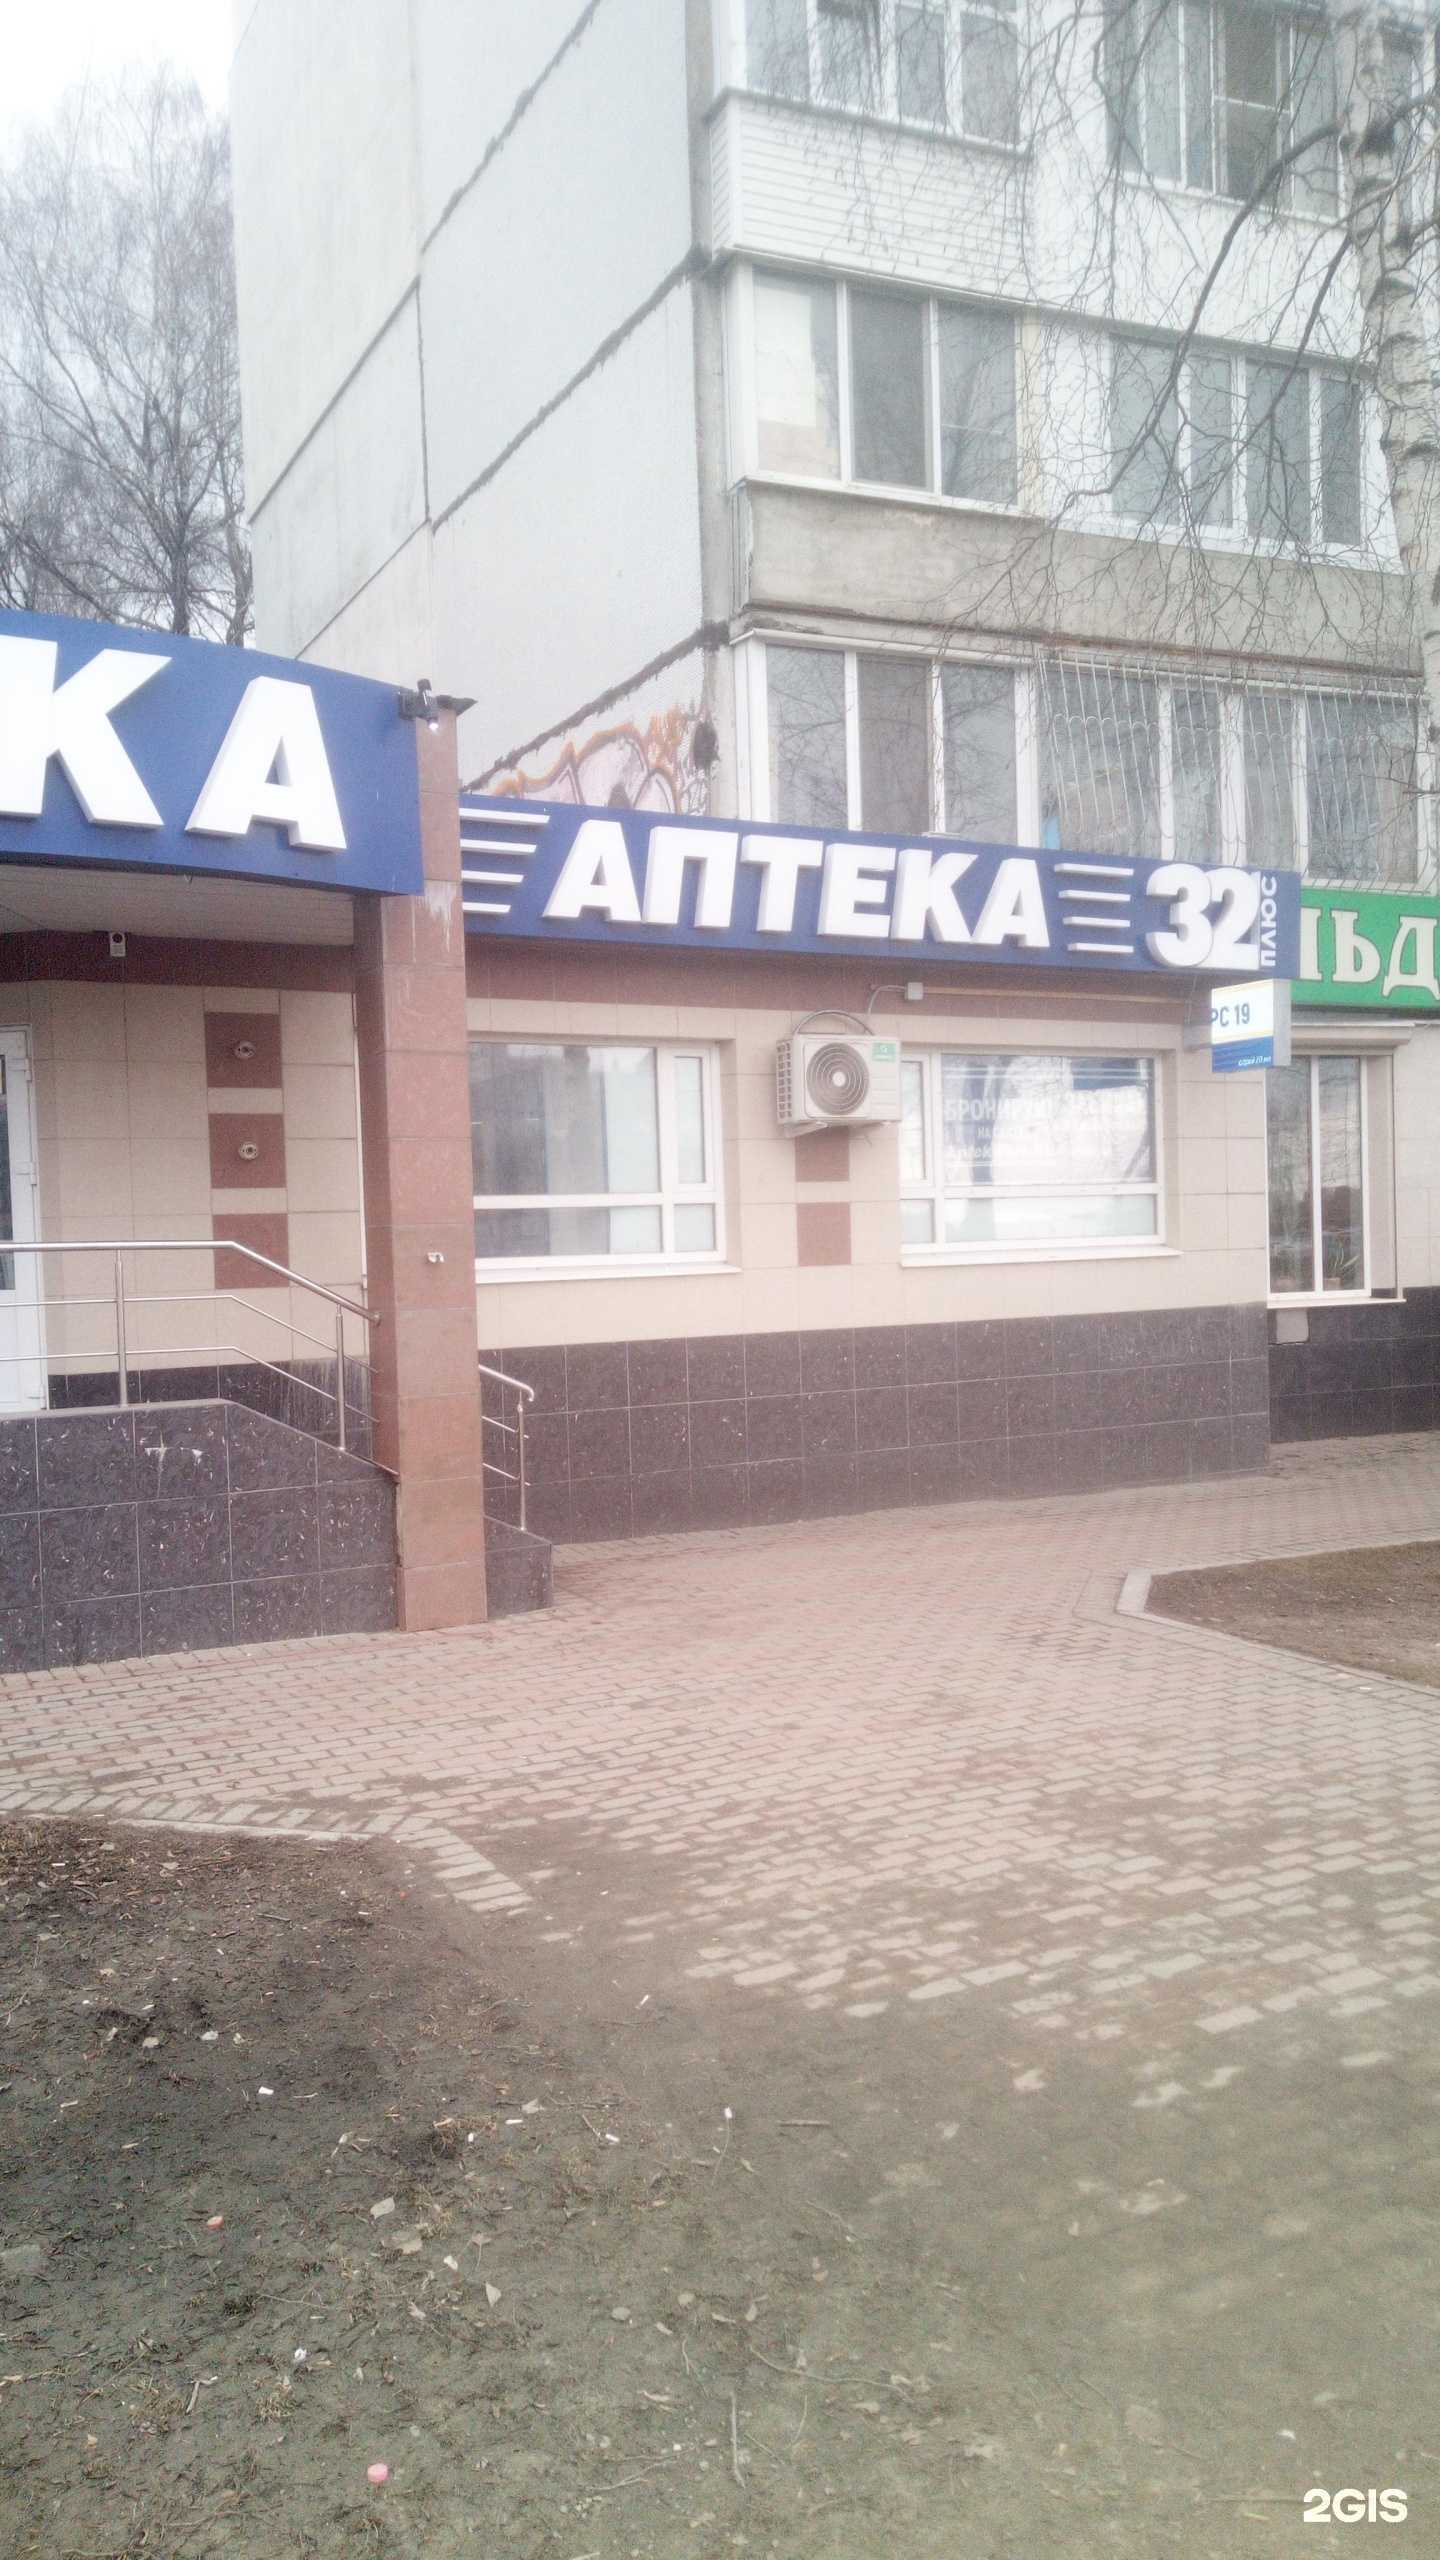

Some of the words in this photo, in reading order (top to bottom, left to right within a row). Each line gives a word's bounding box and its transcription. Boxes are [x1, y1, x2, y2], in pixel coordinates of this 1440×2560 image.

[0, 635, 347, 850] КА
[542, 819, 1051, 948] АПТЕКА
[1145, 863, 1260, 970] 32
[1261, 876, 1277, 967] ПЛЮС
[1234, 1002, 1251, 1026] 19
